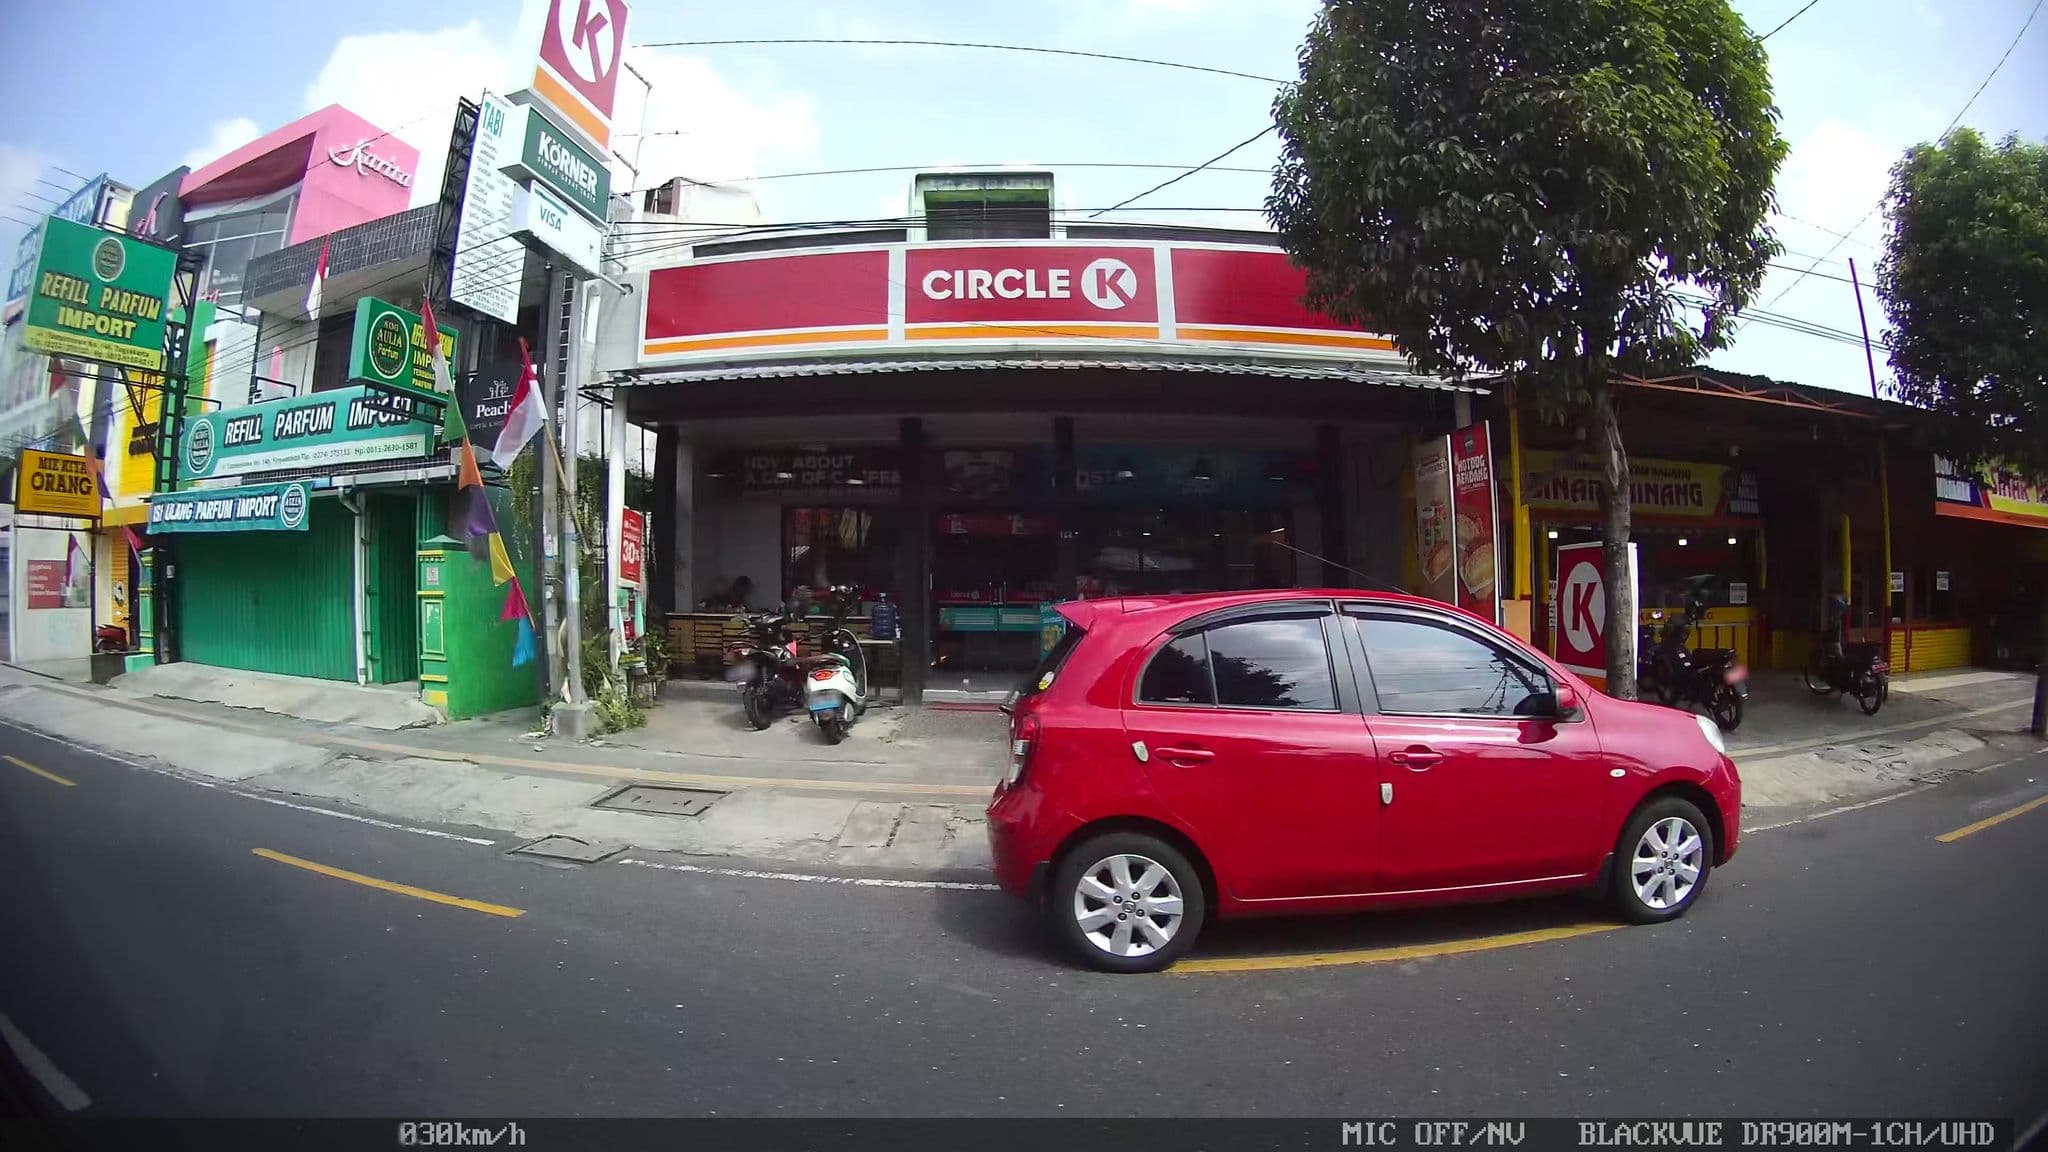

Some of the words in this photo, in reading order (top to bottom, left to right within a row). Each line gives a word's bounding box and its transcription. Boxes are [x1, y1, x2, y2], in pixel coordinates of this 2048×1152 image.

[572, 0, 607, 82] K
[538, 131, 598, 196] KÖRNER
[539, 206, 562, 232] VISA
[40, 272, 90, 305] REFILL
[100, 287, 162, 321] PARFUM
[922, 268, 1071, 301] CIRCLE
[1095, 267, 1137, 308] K
[57, 306, 137, 339] IMPORT
[225, 416, 262, 444] REFILL
[275, 406, 333, 437] PARFUM
[31, 471, 93, 496] ORANG
[164, 501, 193, 521] ULANG
[195, 499, 234, 521] PARFUM
[236, 495, 278, 518] IMPORT
[1571, 582, 1606, 650] K
